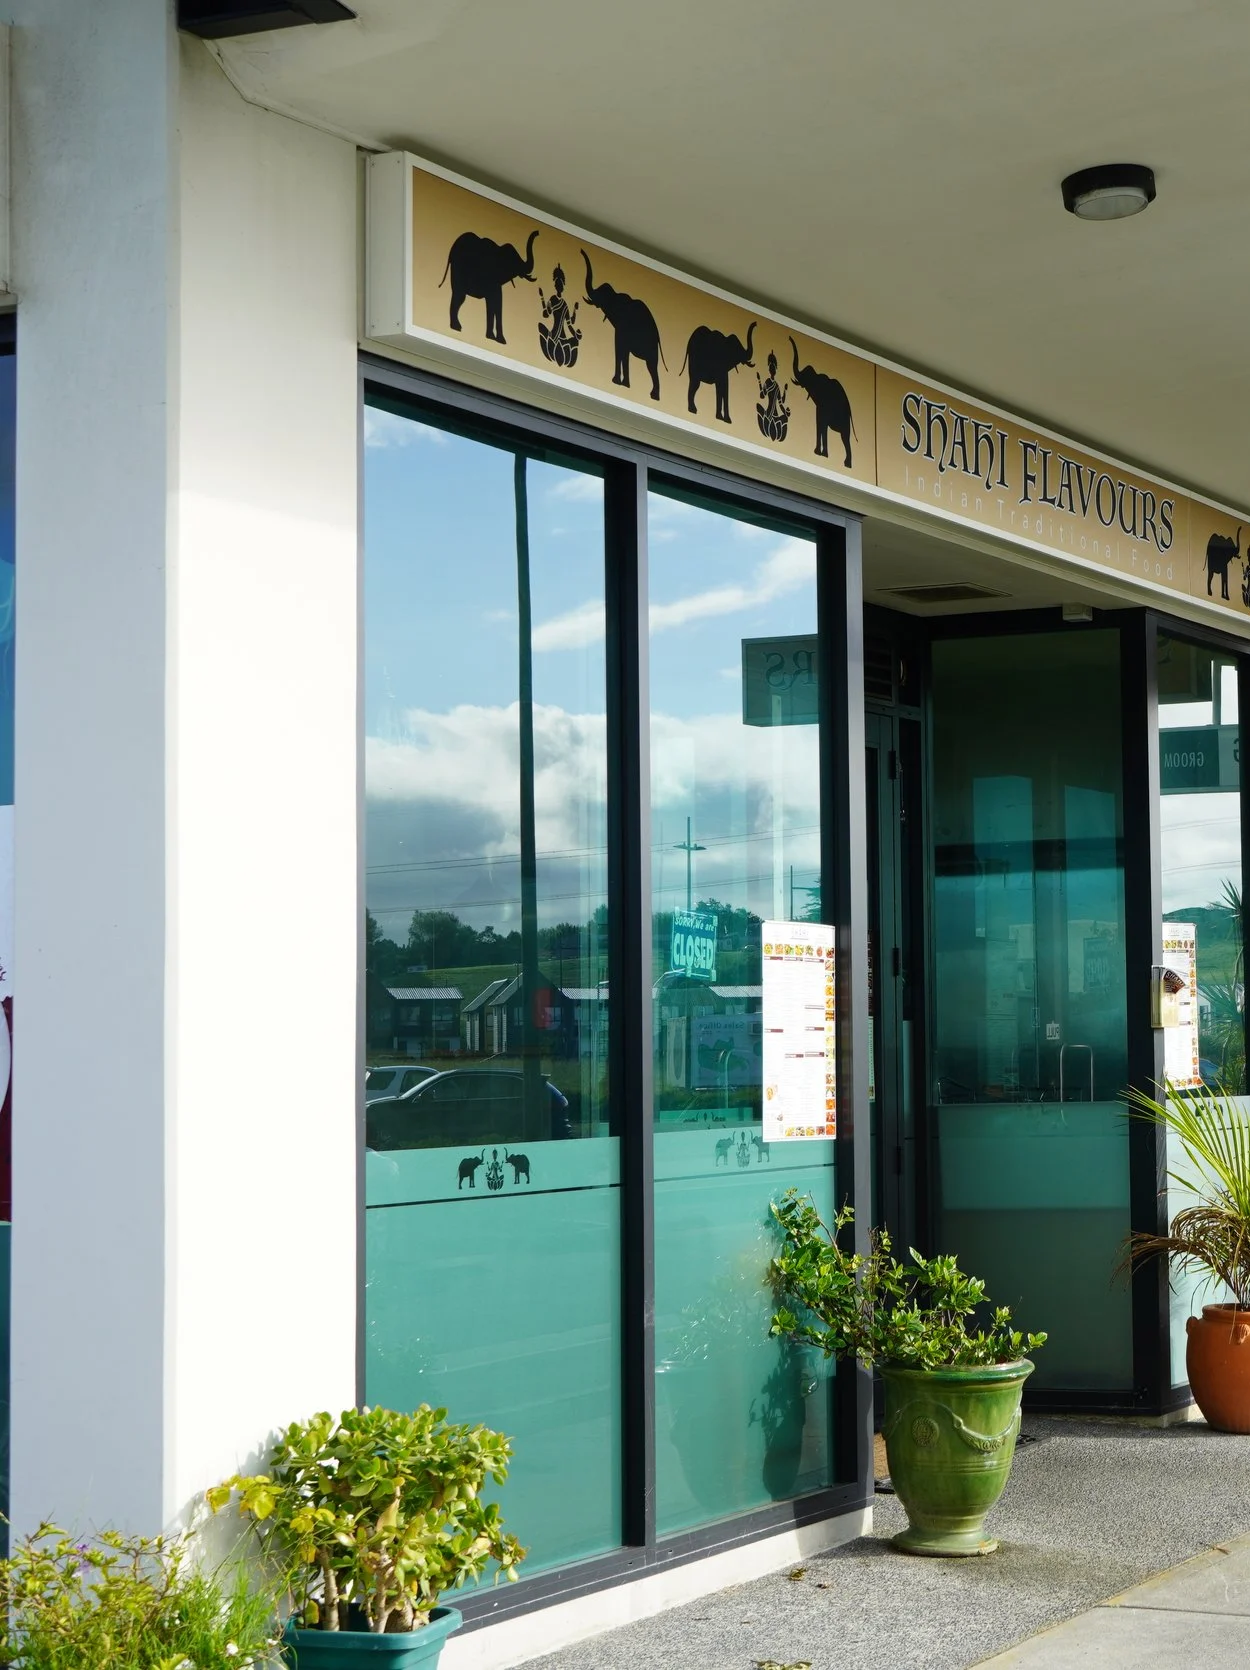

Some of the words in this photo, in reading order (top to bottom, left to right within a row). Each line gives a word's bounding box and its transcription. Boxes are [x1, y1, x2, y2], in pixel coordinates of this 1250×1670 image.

[901, 392, 1009, 491] SHAHI
[1018, 439, 1175, 553] FLAVOURS
[905, 464, 982, 511] Indian
[996, 499, 1120, 561] Traditional
[1131, 548, 1174, 580] Food
[673, 933, 714, 969] CLOSED
[704, 924, 715, 932] are
